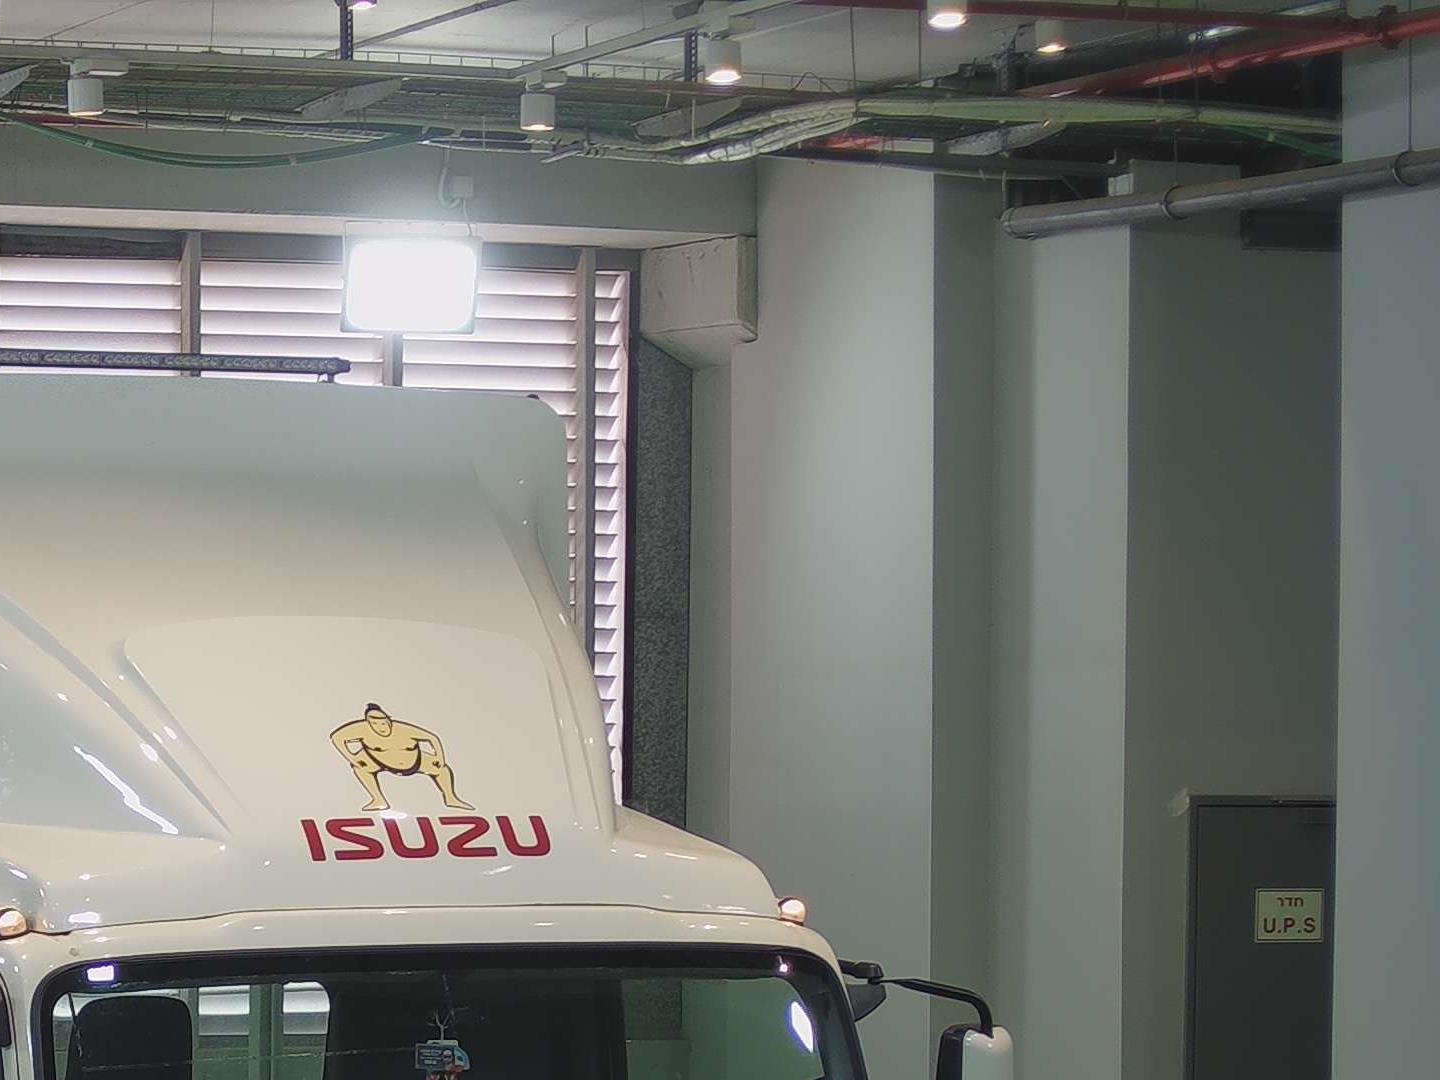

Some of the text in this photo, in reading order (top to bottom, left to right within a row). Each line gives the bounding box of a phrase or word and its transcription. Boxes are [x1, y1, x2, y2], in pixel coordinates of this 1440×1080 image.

[300, 816, 552, 862] ISUZU
[1277, 896, 1304, 907] חדר
[1263, 917, 1316, 934] U.P.S
